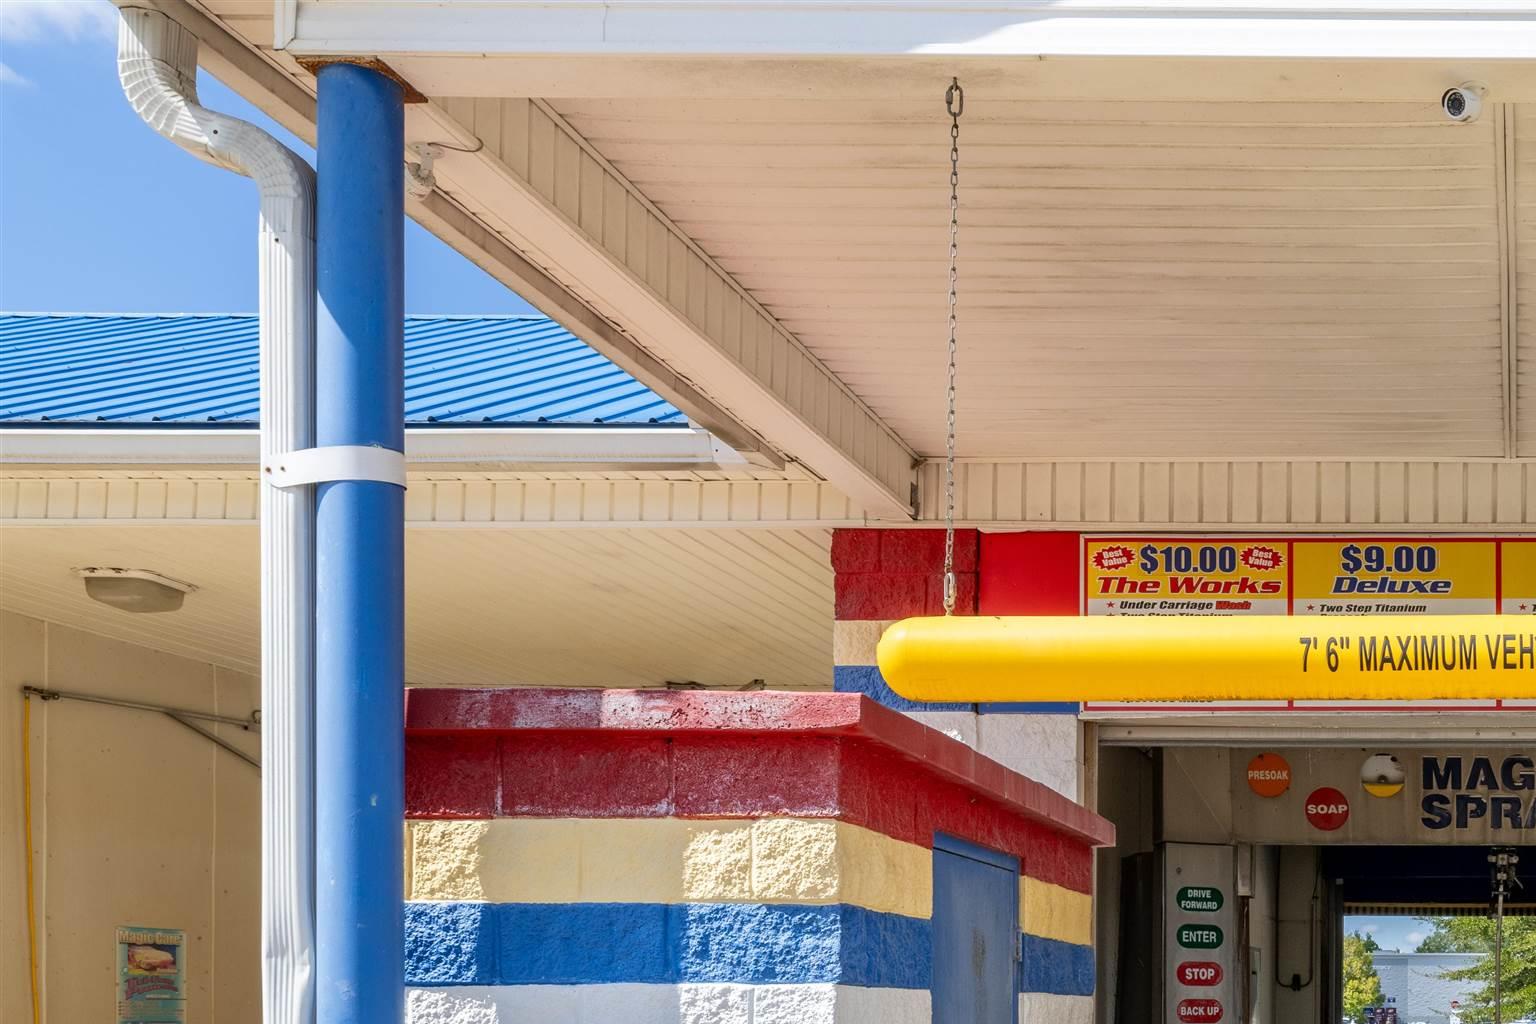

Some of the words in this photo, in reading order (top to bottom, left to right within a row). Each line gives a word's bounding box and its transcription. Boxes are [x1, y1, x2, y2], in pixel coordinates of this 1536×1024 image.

[1102, 549, 1123, 559] Best
[1140, 544, 1236, 574] $10.00
[1252, 549, 1273, 559] Best
[1341, 544, 1436, 574] $9.00
[1102, 557, 1128, 567] Value
[1248, 557, 1274, 567] Value
[1098, 576, 1161, 594] The
[1169, 576, 1281, 594] Works
[1332, 576, 1452, 594] Deluxe
[1119, 601, 1157, 610] Under
[1159, 601, 1213, 612] Carriage
[1319, 604, 1343, 613] Two
[1345, 604, 1372, 614] Step
[1375, 604, 1427, 613] Titanium
[1299, 637, 1318, 673] 7'
[1326, 637, 1350, 673] 6"
[1359, 635, 1478, 672] MAXIMUM
[1248, 770, 1289, 780] PRESOAK
[1307, 804, 1348, 814] SOAP
[1187, 889, 1212, 898] DRIVE
[1181, 900, 1218, 910] FORWARD
[1182, 930, 1217, 943] ENTER
[1185, 968, 1215, 980] STOP
[1180, 1006, 1205, 1016] BACK
[1207, 1006, 1220, 1015] UP
